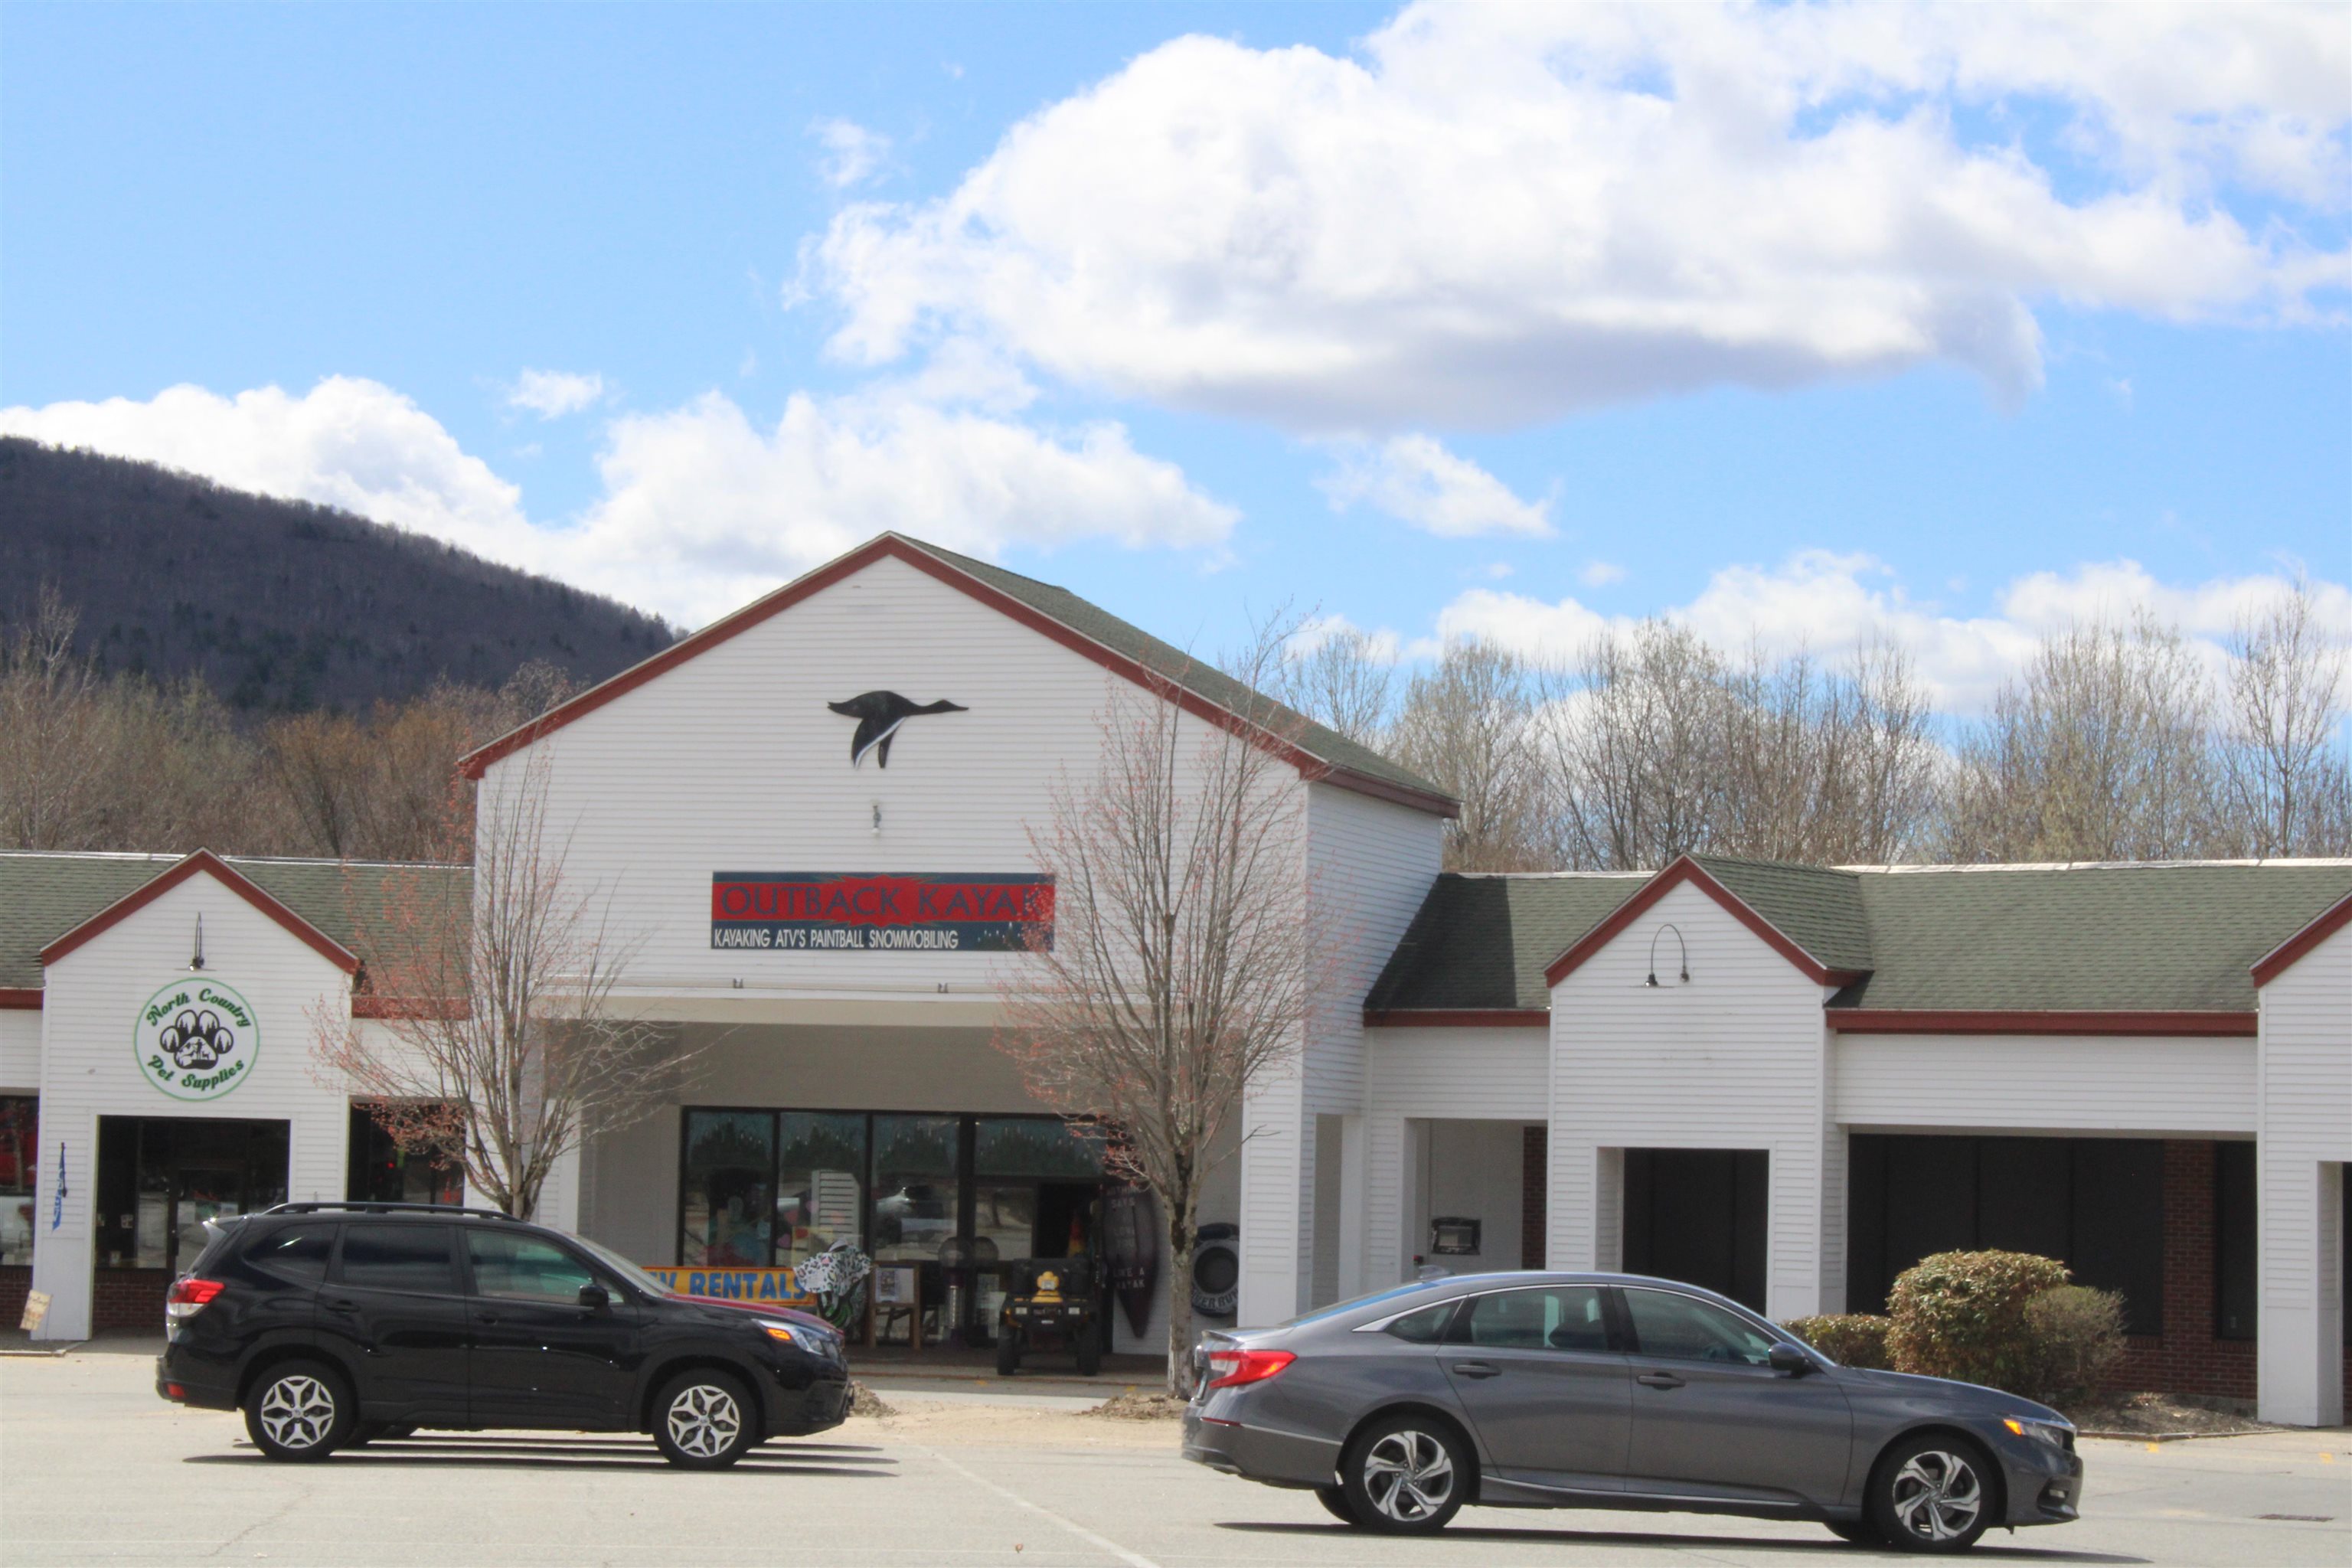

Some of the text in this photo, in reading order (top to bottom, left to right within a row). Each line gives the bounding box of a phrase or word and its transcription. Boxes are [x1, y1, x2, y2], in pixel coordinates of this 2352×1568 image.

[721, 885, 1043, 916] OUTBACK KAYAK
[714, 929, 959, 949] KAYAKING ATV'S PAINTBALL SNOWMOBILING
[146, 988, 251, 1028] North Country
[148, 1054, 244, 1091] Pet Supplies
[690, 1272, 807, 1299] RENTALS
